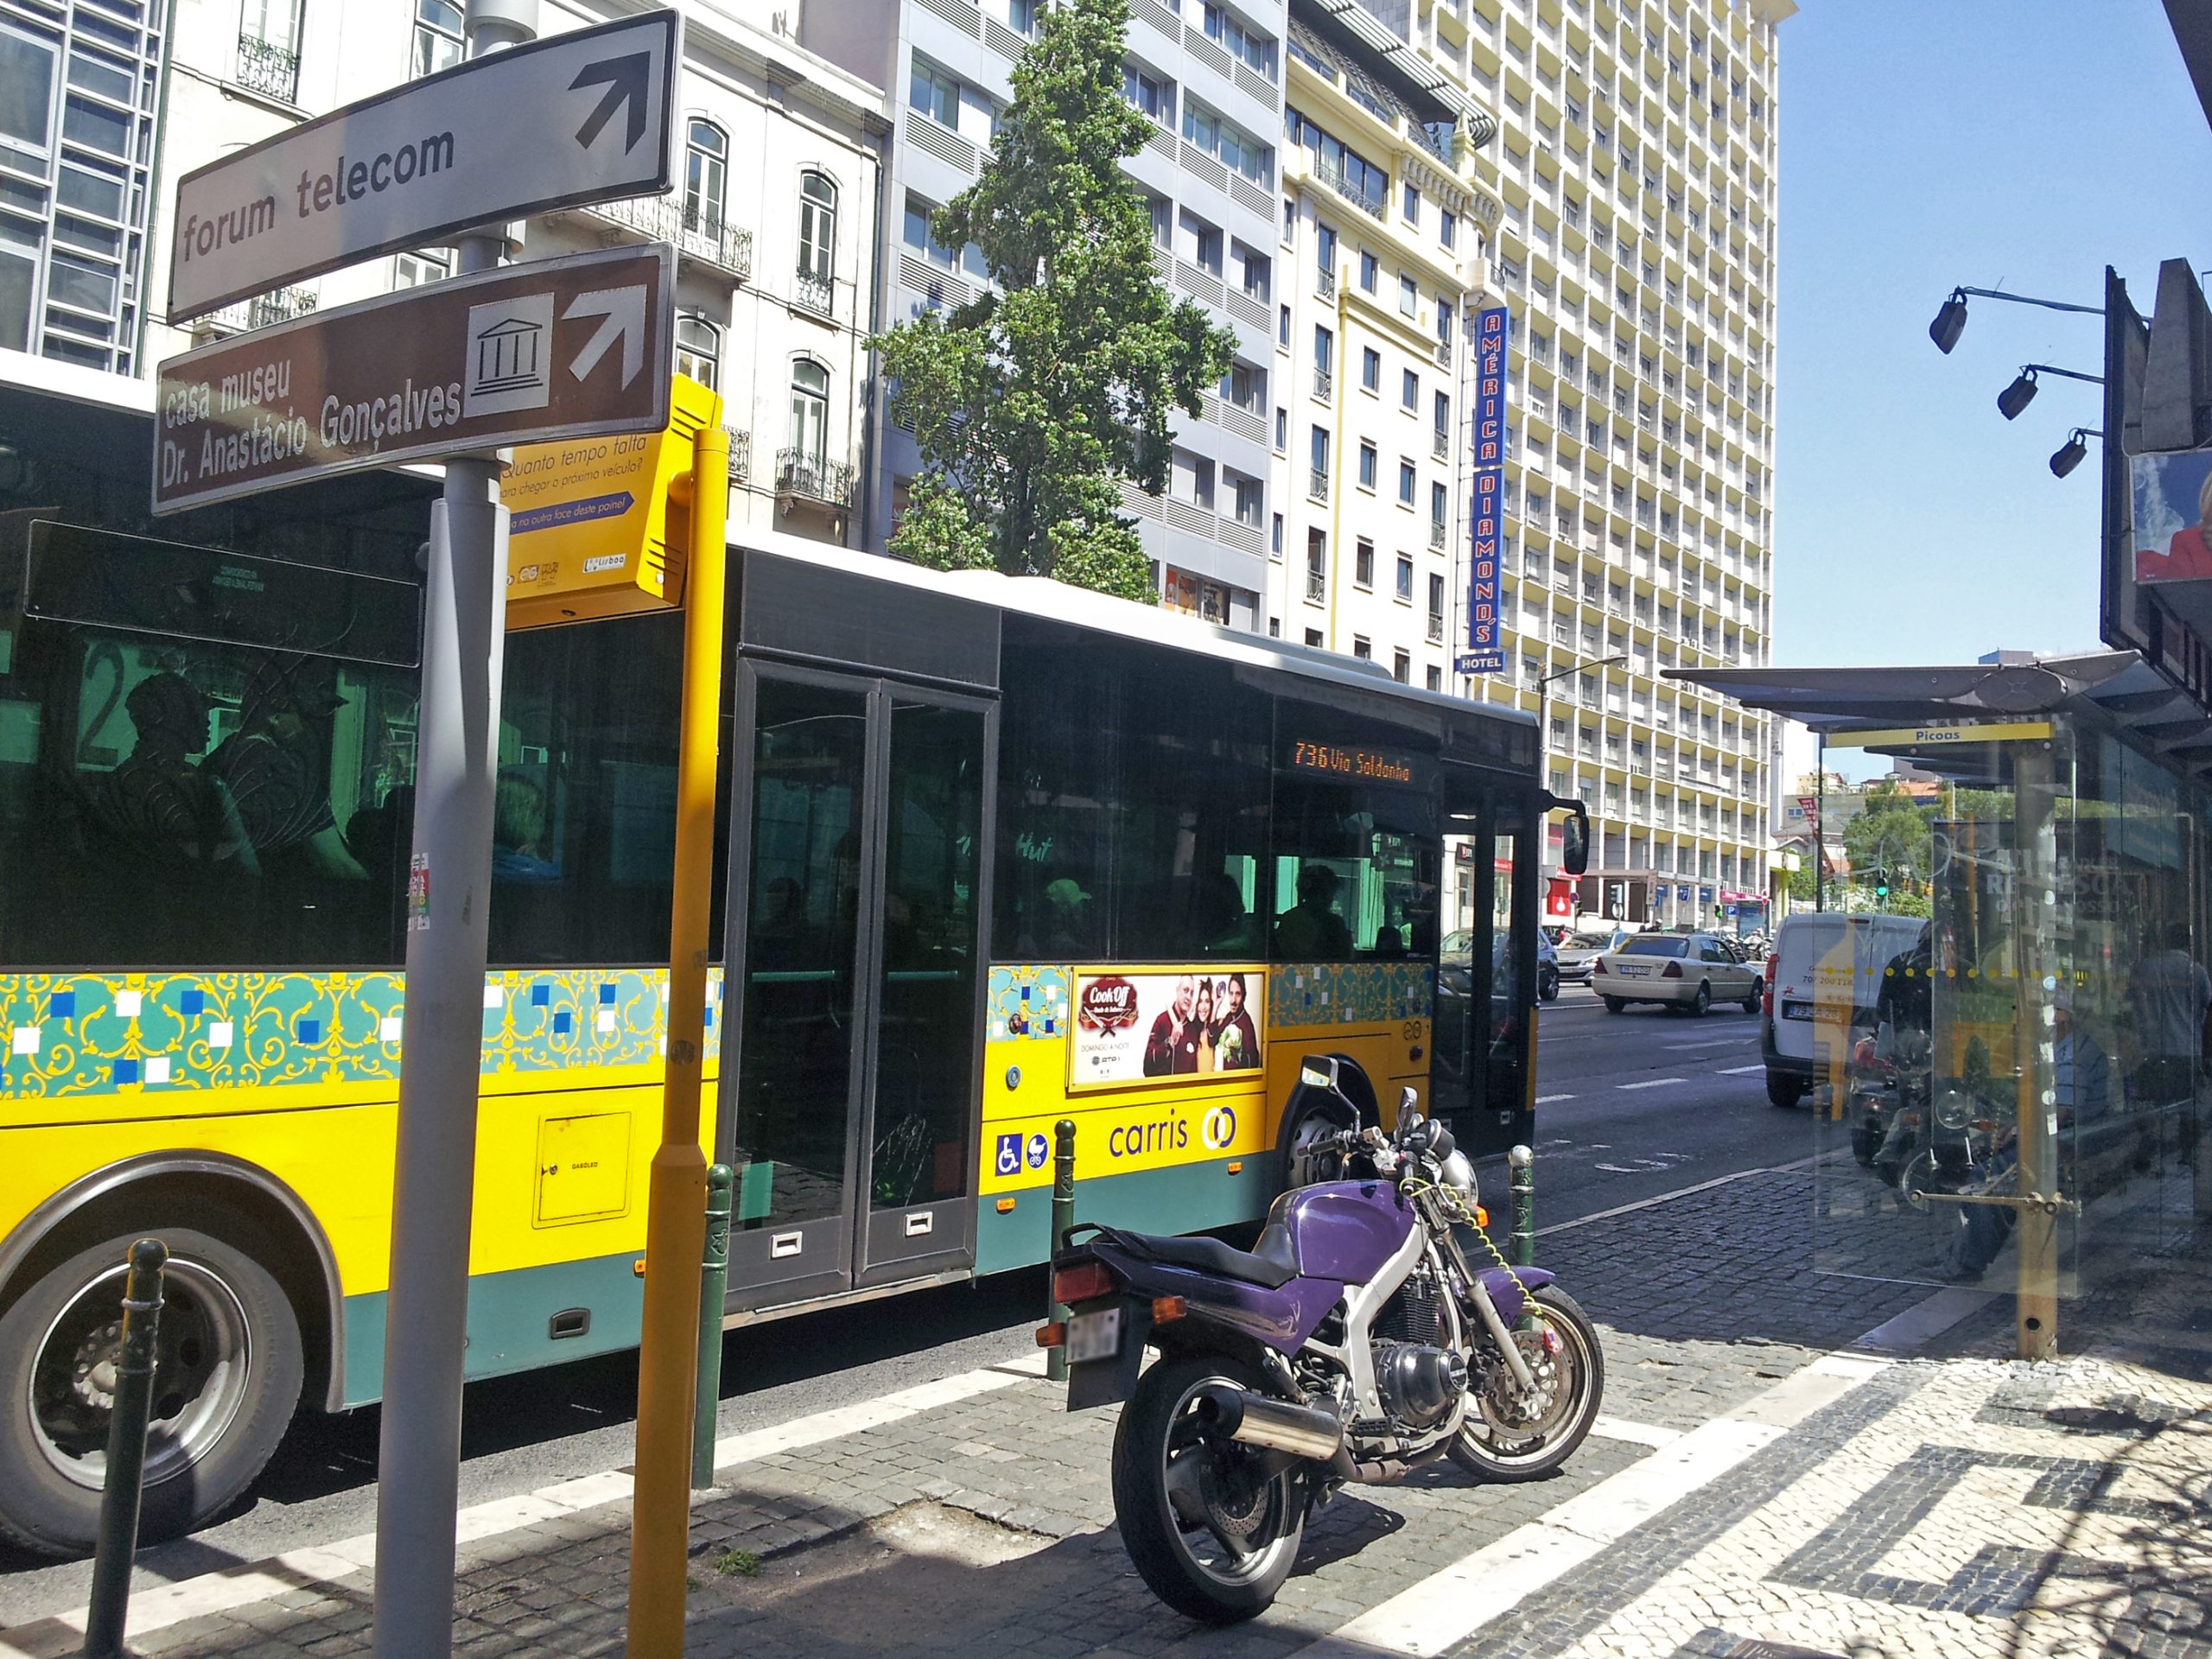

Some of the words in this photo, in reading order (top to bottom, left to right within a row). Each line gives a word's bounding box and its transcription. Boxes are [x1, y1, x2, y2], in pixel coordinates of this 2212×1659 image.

[184, 194, 275, 262] forum
[297, 131, 454, 218] telecom
[166, 381, 209, 429] casa
[220, 359, 290, 414] museu
[1481, 315, 1501, 460] AMÉRICA
[162, 440, 188, 487] Dr.
[199, 405, 307, 479] Anastácio
[320, 378, 461, 453] Gonçalves
[562, 445, 607, 467] tempo
[500, 488, 517, 499] ara
[519, 480, 550, 495] chegar
[552, 479, 559, 487] o
[562, 470, 600, 488] próximo
[602, 458, 643, 477] veículo?
[531, 513, 552, 524] outra
[574, 505, 596, 517] deste
[1461, 658, 1502, 669] HOTEL
[1916, 730, 1961, 741] Picoas
[1295, 741, 1328, 768] 736
[1331, 748, 1351, 772] Via
[1356, 753, 1410, 781] Saldanha
[1109, 1108, 1188, 1157] carris
